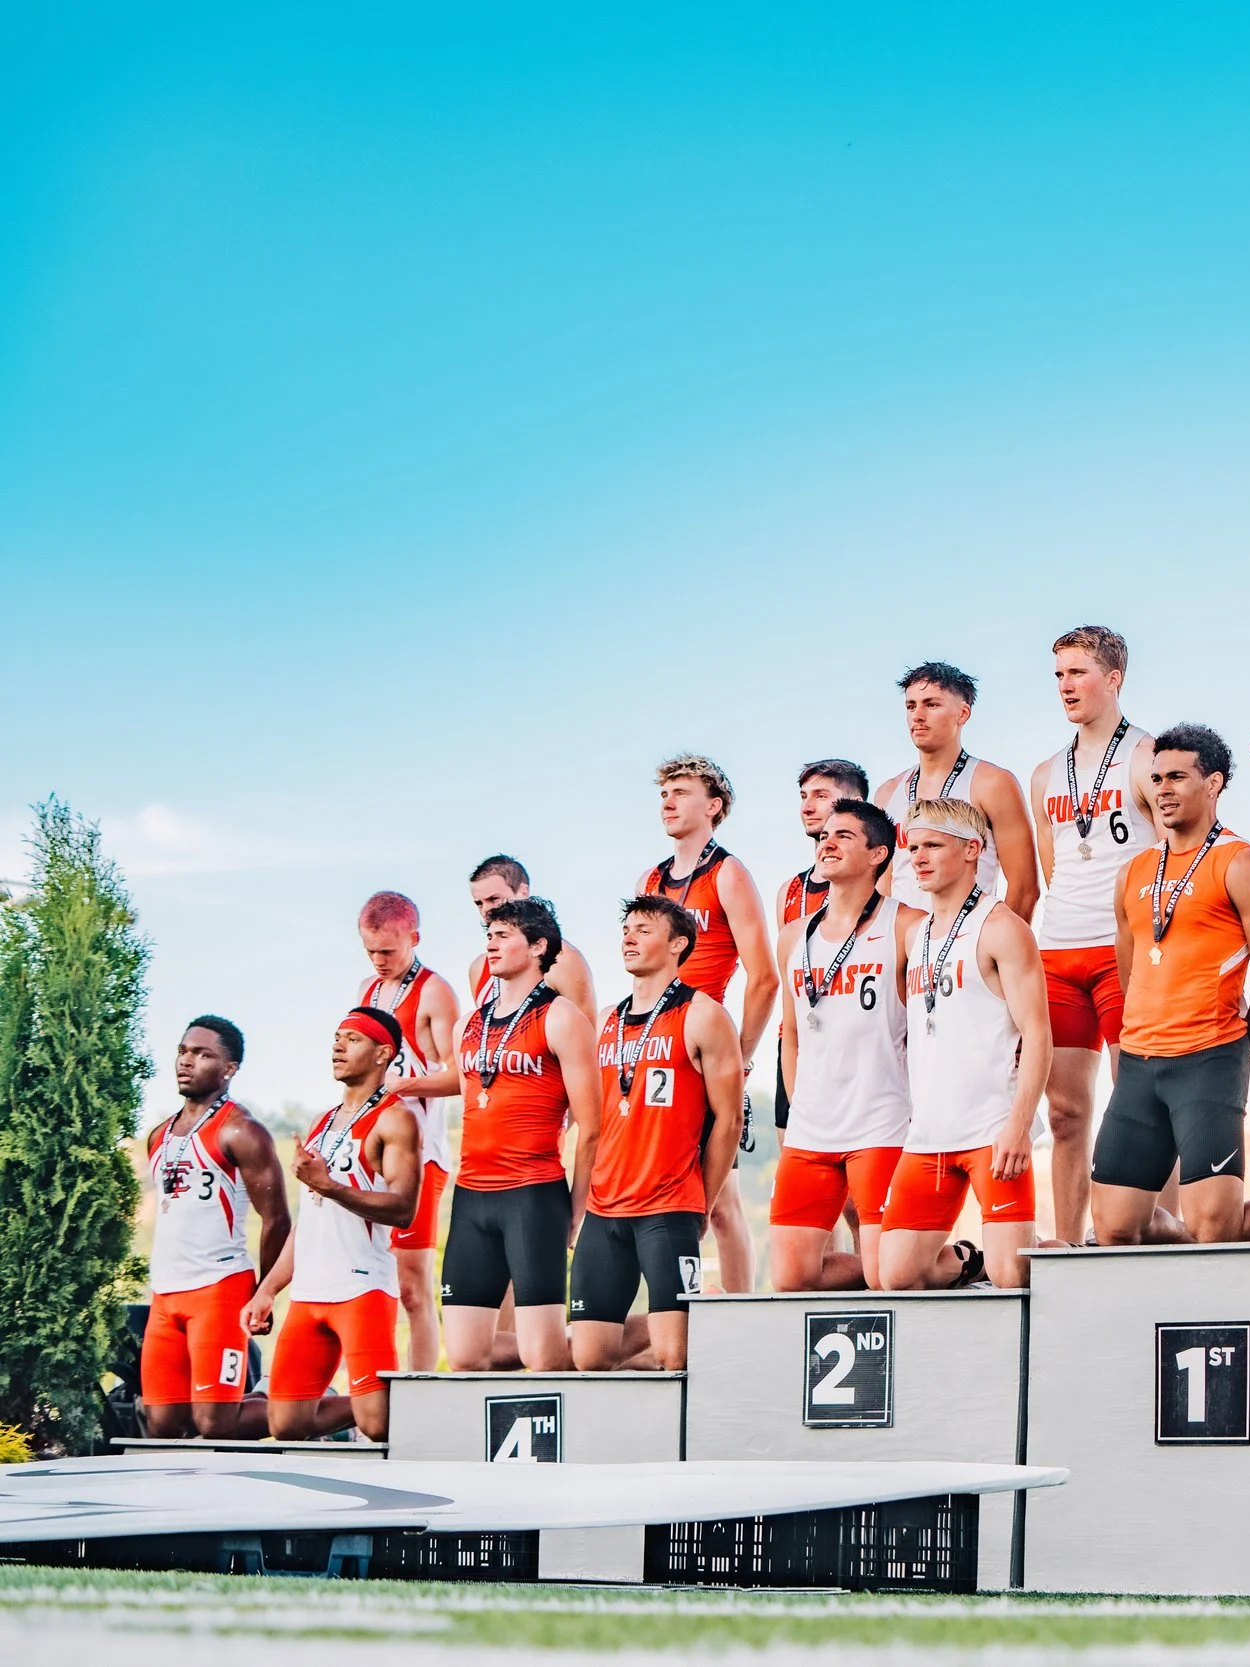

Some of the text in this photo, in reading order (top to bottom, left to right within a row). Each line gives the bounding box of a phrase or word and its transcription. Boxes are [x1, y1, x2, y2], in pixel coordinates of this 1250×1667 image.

[1109, 810, 1129, 845] 6
[859, 975, 877, 1011] 6
[939, 961, 953, 998] 6
[650, 1069, 668, 1104] 2
[339, 1141, 354, 1172] 3
[198, 1171, 215, 1200] 3
[685, 1258, 698, 1290] 2
[226, 1352, 239, 1382] 3
